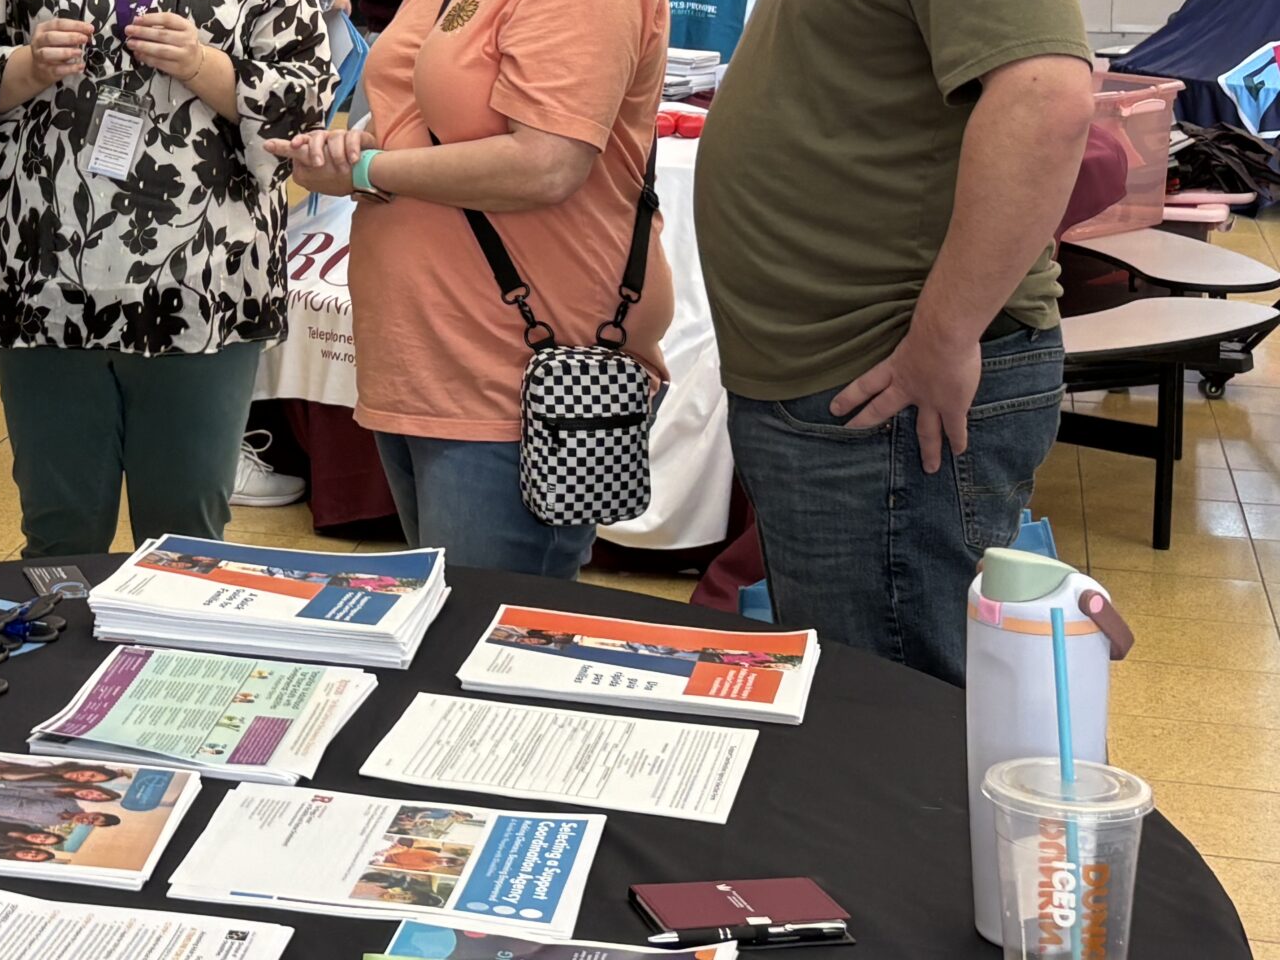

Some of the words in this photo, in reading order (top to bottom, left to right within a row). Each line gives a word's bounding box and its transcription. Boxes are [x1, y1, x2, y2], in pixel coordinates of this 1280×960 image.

[520, 821, 555, 873] Coordination
[544, 822, 578, 858] Selecting
[501, 872, 534, 904] Agency
[532, 866, 561, 900] Support
[1052, 861, 1077, 928] ICED
